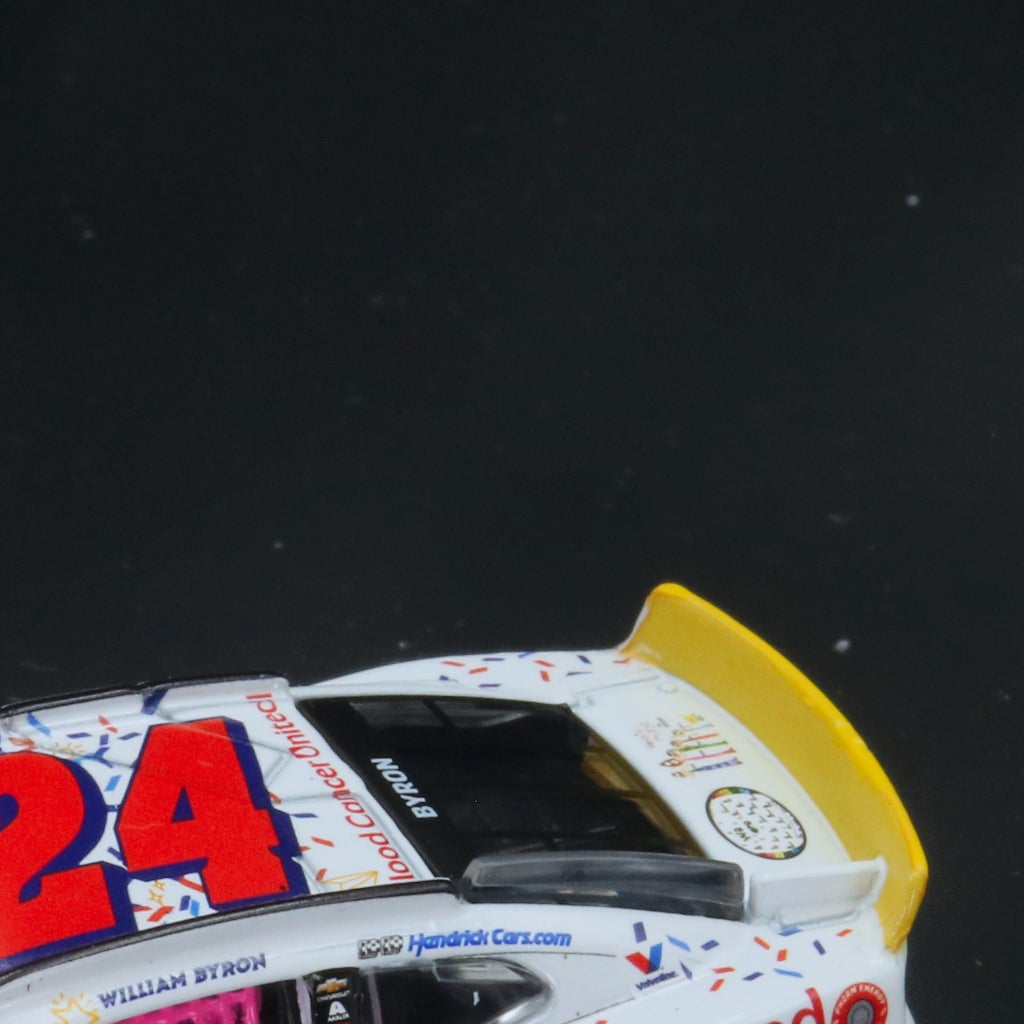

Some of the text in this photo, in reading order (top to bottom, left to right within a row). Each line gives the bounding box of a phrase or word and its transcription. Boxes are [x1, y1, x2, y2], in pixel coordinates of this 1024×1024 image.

[246, 692, 415, 881] lood Cancer United
[371, 757, 439, 819] BYRON
[97, 952, 267, 1010] WILLIAM BYRON
